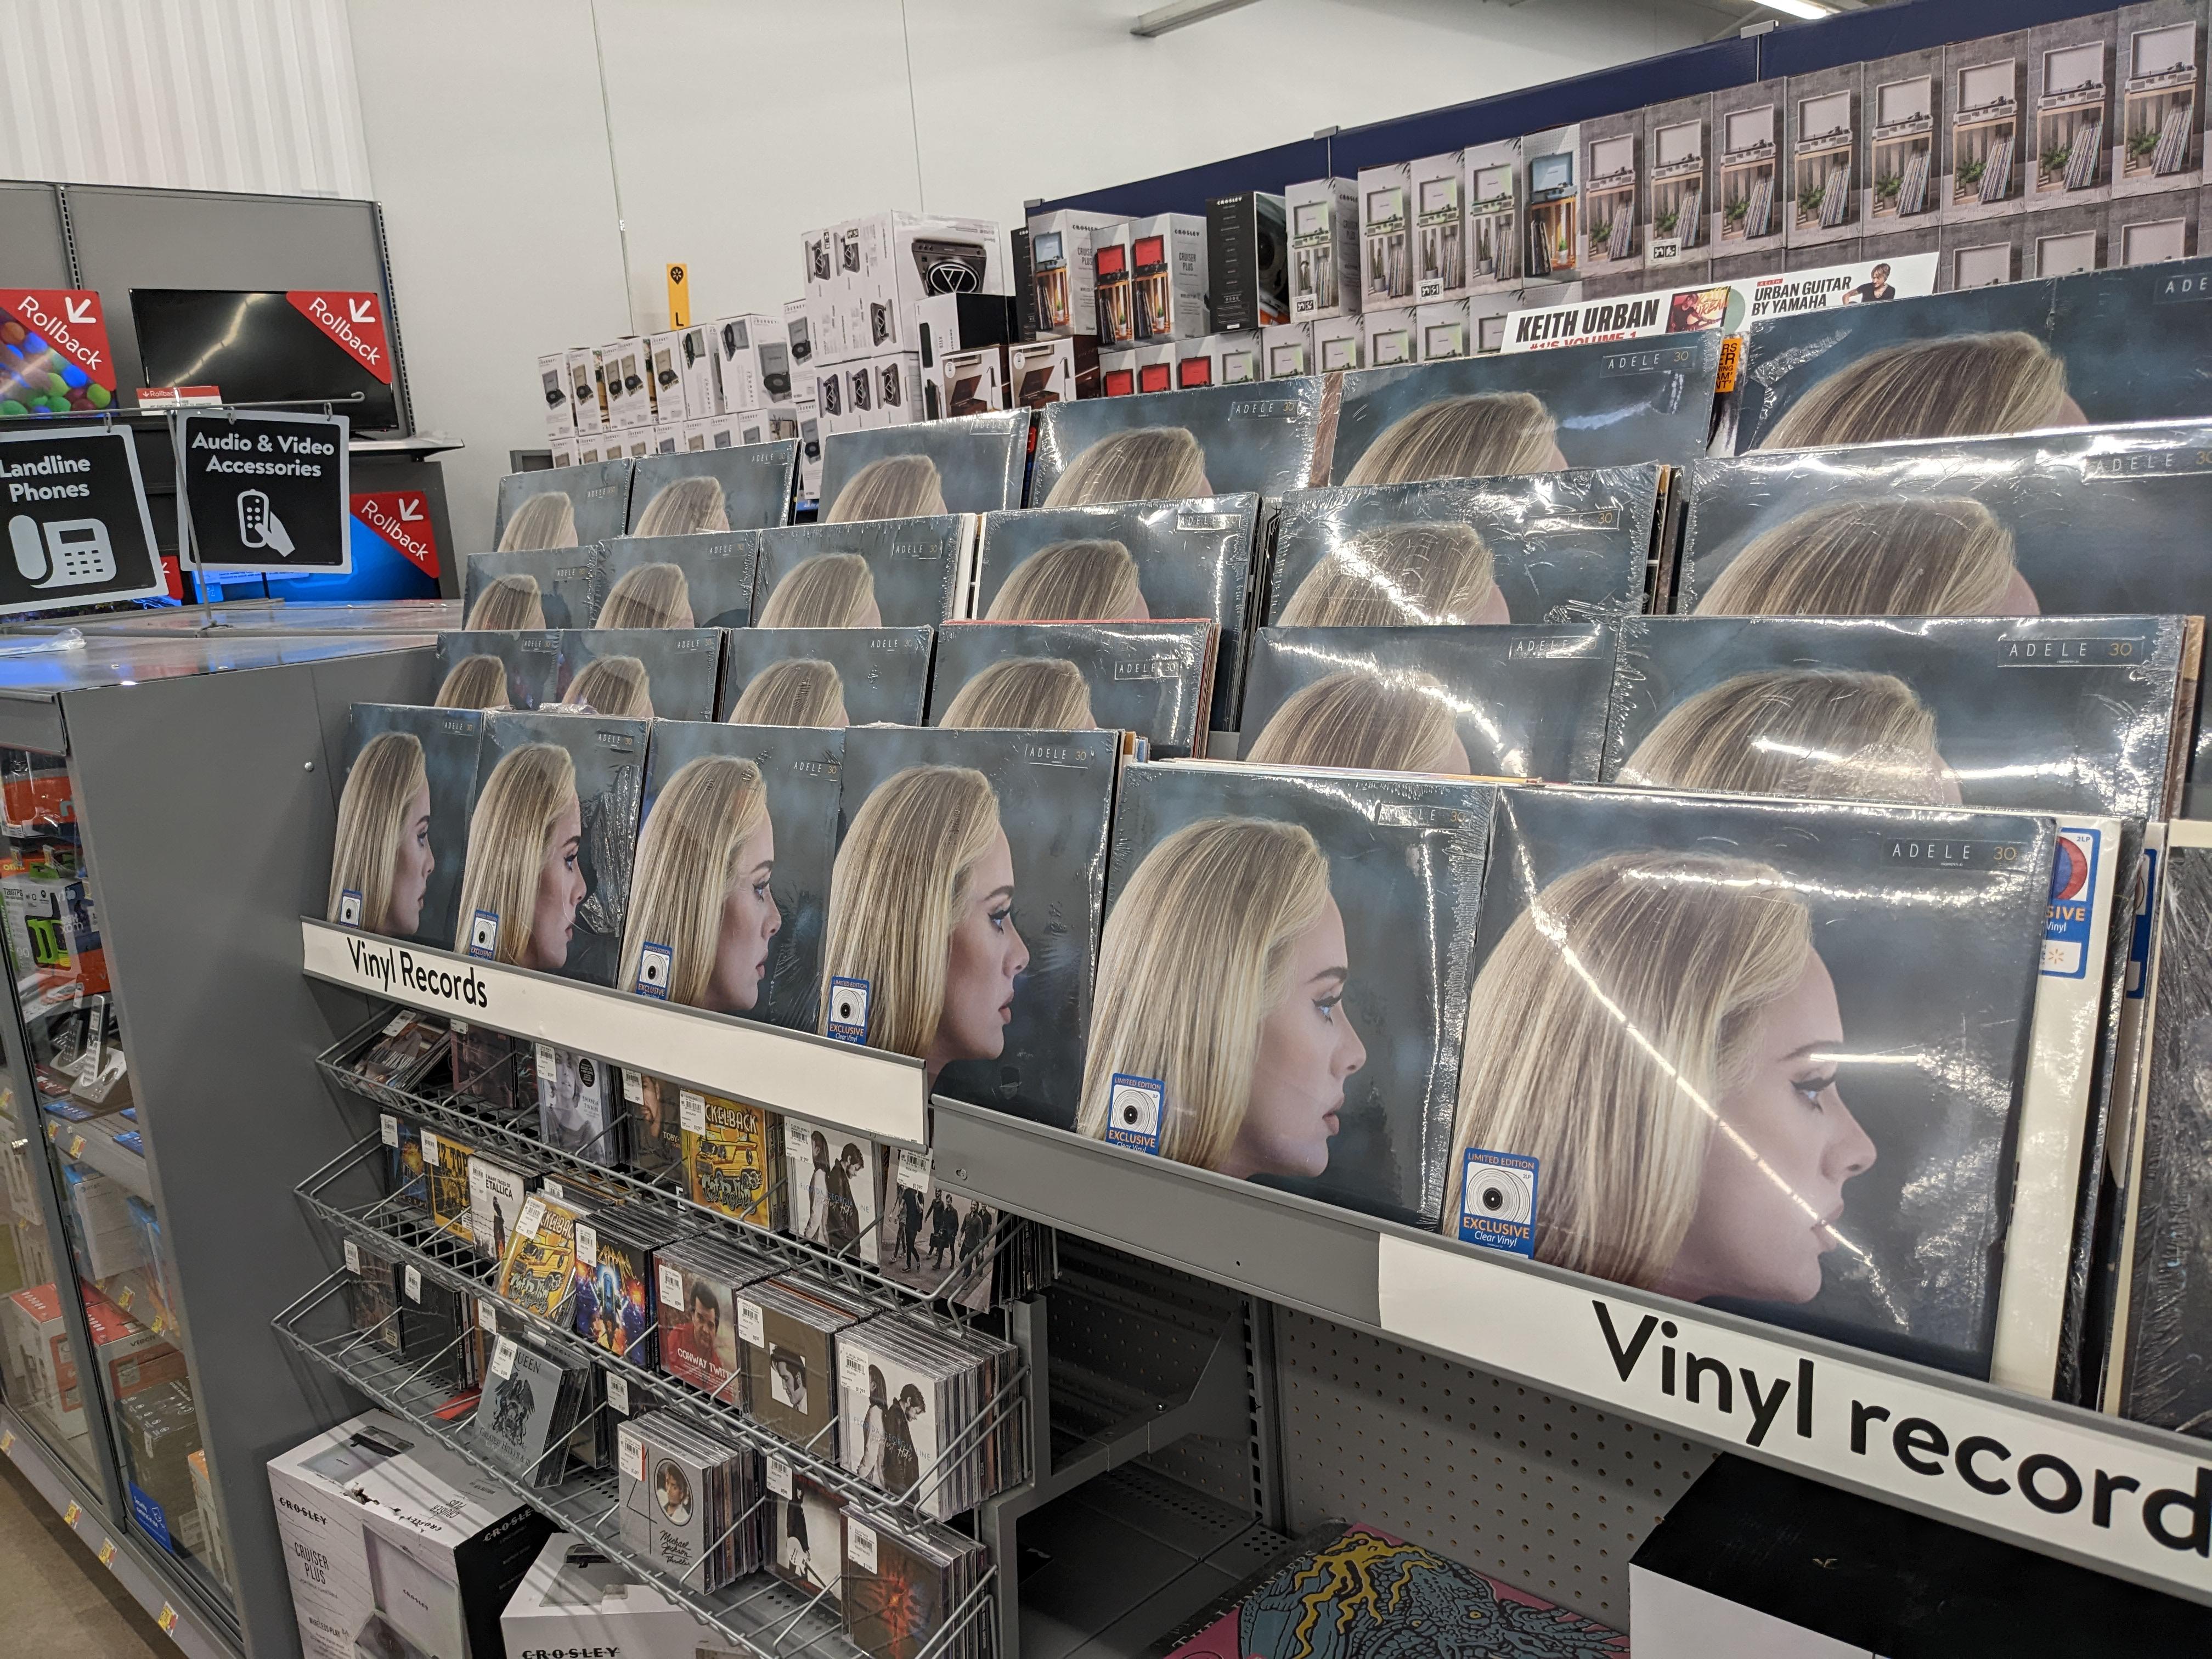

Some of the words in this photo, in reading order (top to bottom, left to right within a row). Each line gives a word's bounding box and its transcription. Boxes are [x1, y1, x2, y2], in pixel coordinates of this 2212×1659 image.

[1217, 197, 1243, 206] CROSLEY
[1183, 262, 1193, 271] PLUS
[1754, 283, 1800, 301] URBAN
[1802, 276, 1852, 296] GUITAR
[2165, 277, 2208, 294] ADE
[1751, 302, 1769, 316] BY
[1769, 294, 1827, 313] YAMAHA
[675, 312, 684, 326] L
[1516, 311, 1580, 343] KEITH
[1582, 298, 1660, 335] URBAN
[17, 295, 103, 371] Rollback
[308, 297, 381, 366] Rollback
[1564, 332, 1625, 346] VOLUME
[1608, 353, 1660, 369] ADELE
[1674, 351, 1689, 362] 30
[1235, 403, 1273, 414] ADELE
[1283, 402, 1295, 411] 30
[191, 432, 252, 452] Audio
[257, 435, 273, 453] &
[278, 435, 335, 456] Video
[206, 455, 322, 477] Accessories
[752, 453, 774, 462] ADELE
[2095, 453, 2174, 474] ADELE
[0, 455, 91, 478] Landline
[9, 482, 91, 503] Phones
[588, 488, 605, 498] ADELE
[1180, 515, 1216, 526] ADELE
[1598, 512, 1613, 524] 30
[360, 499, 429, 561] Rollback
[710, 544, 732, 554] ADELE
[896, 545, 923, 553] ADELE
[929, 545, 938, 553] 30
[678, 640, 699, 648] ADELE
[871, 639, 898, 648] ADELE
[1516, 639, 1567, 652] ADELE
[2009, 642, 2087, 657] ADELE
[2108, 643, 2132, 656] 30
[1119, 663, 1155, 673] ADELE
[1165, 662, 1176, 672] 30
[444, 722, 462, 731] ADELE
[598, 734, 620, 743] ADELE
[1029, 748, 1066, 759] ADELE
[1075, 751, 1086, 760] 30
[794, 761, 822, 772] ADELE
[828, 765, 837, 775] 30
[1450, 811, 1465, 822] 30
[1892, 843, 1971, 860] ADELE
[1993, 847, 2017, 861] 30
[2046, 922, 2067, 934] Vinyl
[346, 936, 397, 992] Vinyl
[400, 950, 488, 1008] Records
[638, 983, 665, 996] EXCLUSIVE
[830, 1023, 865, 1037] EXCLUSIVE
[835, 1032, 847, 1041] Clear
[847, 1035, 857, 1043] Vinyl
[1114, 1077, 1137, 1087] LIMITED
[1137, 1080, 1161, 1091] EDITION
[705, 1104, 758, 1135] CKELBACK
[1109, 1129, 1155, 1148] EXCLUSIVE
[1468, 1153, 1499, 1164] LIMITED
[1500, 1158, 1534, 1170] EDITION
[486, 1181, 514, 1200] ETALLICA
[540, 1210, 574, 1239] CKELBAC
[1463, 1217, 1531, 1239] EXCLUSIVE
[1474, 1231, 1494, 1243] Clear
[1495, 1234, 1518, 1248] Vinyl
[678, 1347, 707, 1369] CONWAY
[709, 1363, 732, 1379] TWITT
[1592, 1299, 1814, 1447] Vinyl
[279, 1497, 328, 1526] CROSLEY
[430, 1504, 459, 1519] CRUISER
[483, 1508, 535, 1543] CROSLE
[660, 1530, 691, 1551] Michael
[294, 1542, 329, 1571] CRUISER
[661, 1542, 692, 1560] Jackson
[666, 1555, 692, 1567] Thriller
[305, 1562, 326, 1585] PLUS
[403, 1589, 429, 1611] CROSLEY
[309, 1617, 331, 1634] WIRELESS
[330, 1627, 341, 1639] PLAY
[518, 1646, 621, 1659] CROSLEY
